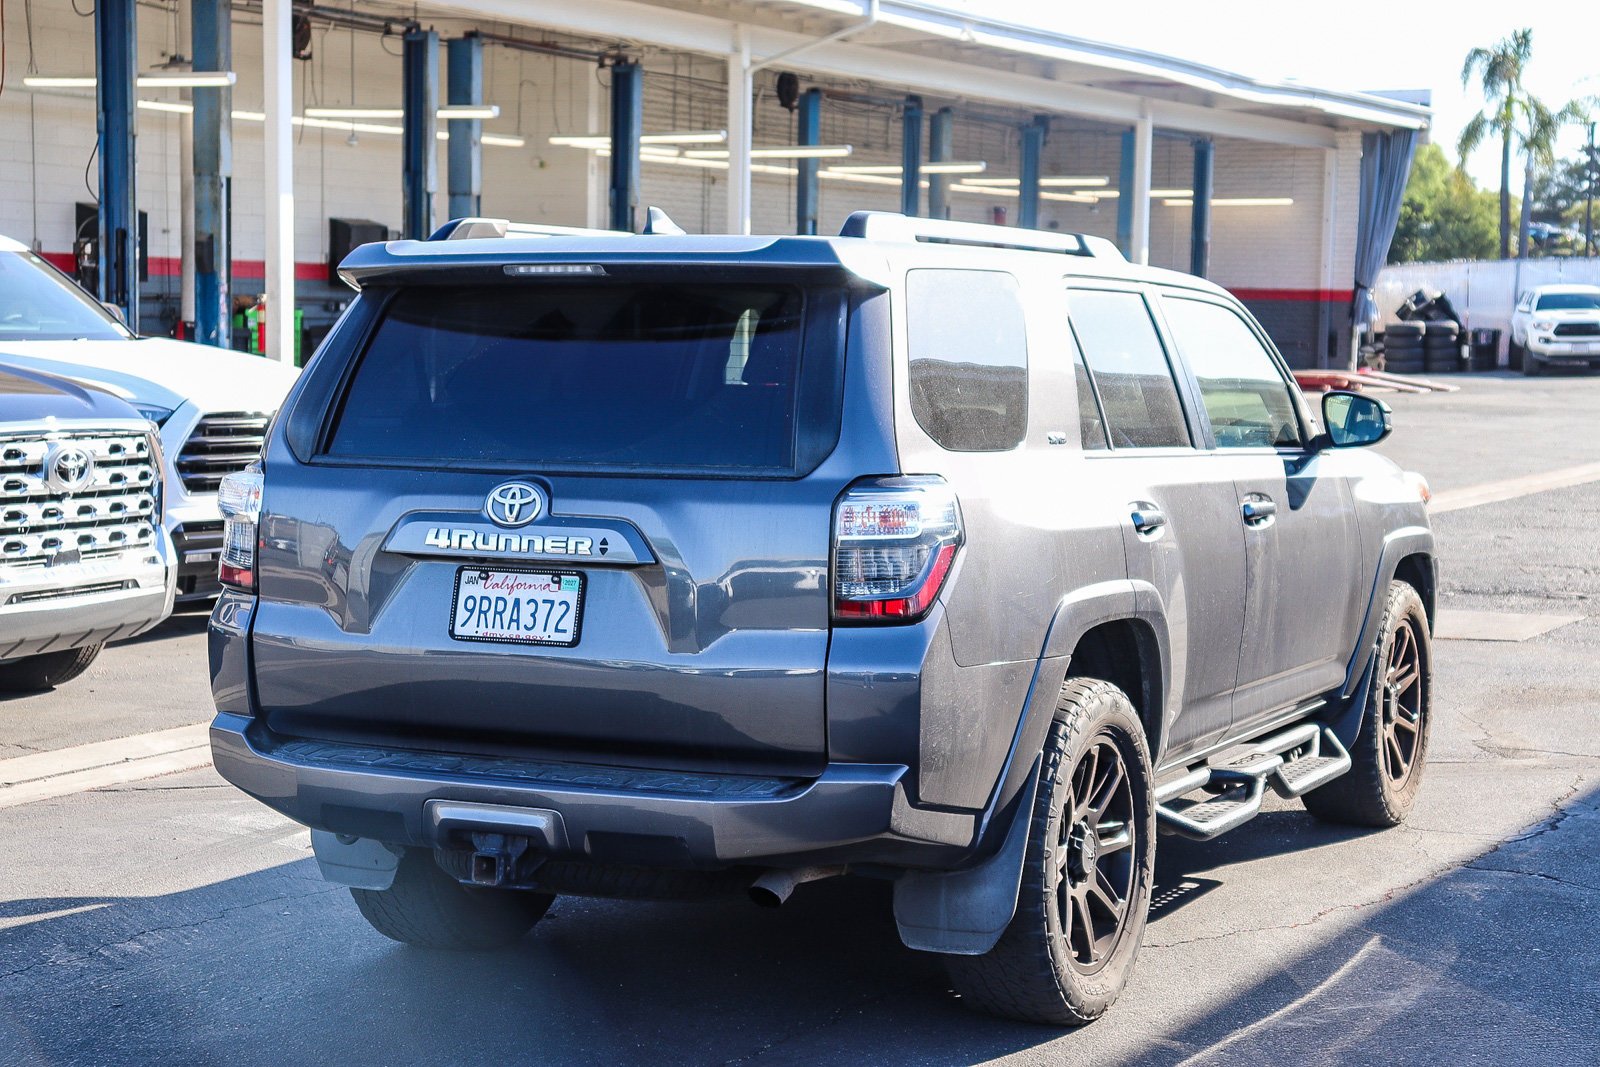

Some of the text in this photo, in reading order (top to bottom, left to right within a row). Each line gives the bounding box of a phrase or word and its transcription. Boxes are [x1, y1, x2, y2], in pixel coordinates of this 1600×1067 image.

[464, 575, 479, 585] JAN
[483, 574, 556, 595] California
[460, 595, 571, 633] 9RRA372
[482, 631, 545, 641] dmv.ca.gov
